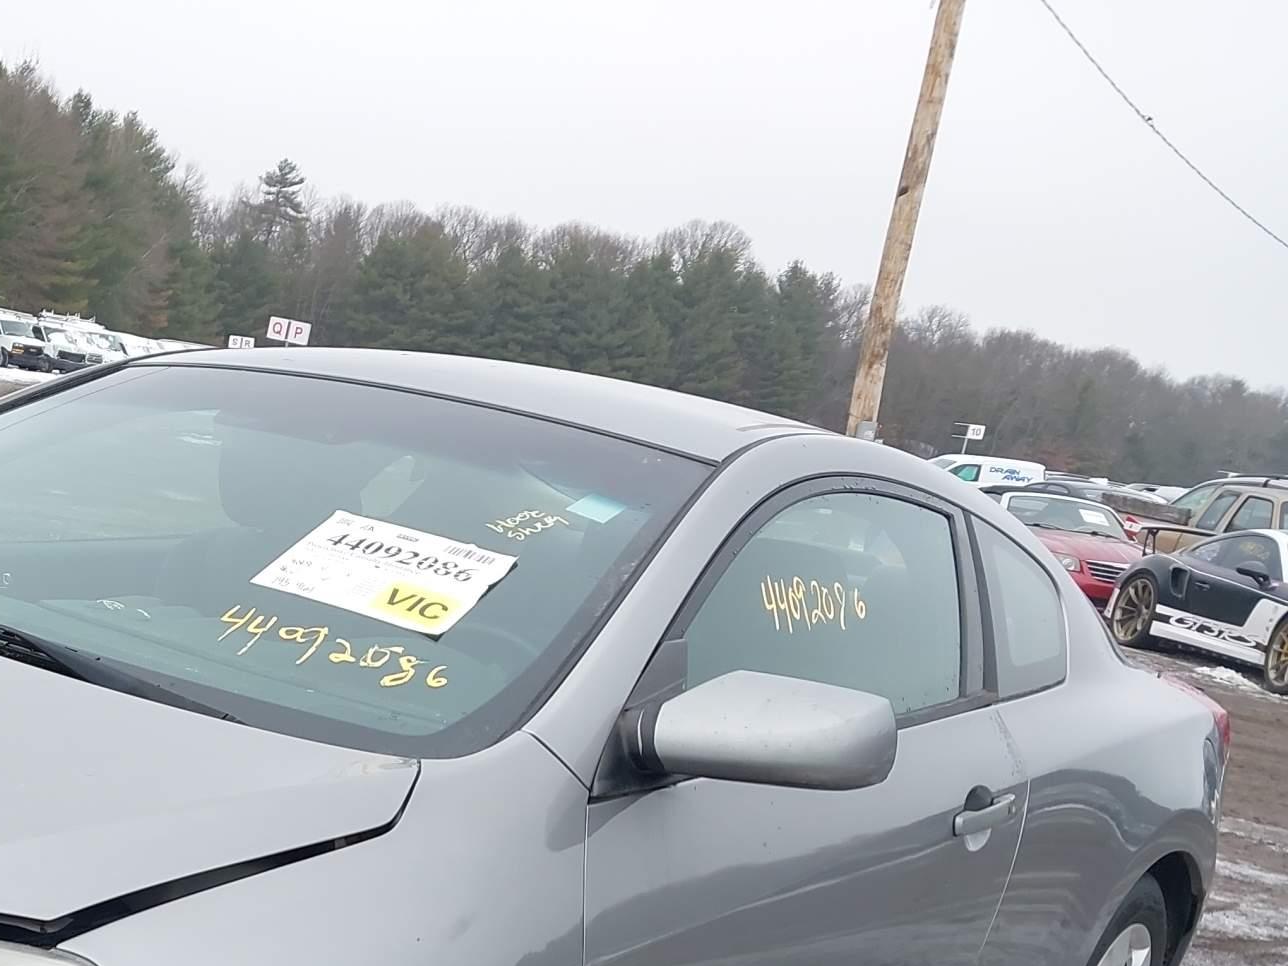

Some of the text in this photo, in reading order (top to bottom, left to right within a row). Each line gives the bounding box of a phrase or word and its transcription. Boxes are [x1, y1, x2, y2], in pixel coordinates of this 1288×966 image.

[273, 322, 304, 339] Q P
[327, 533, 479, 583] 44092086
[386, 587, 449, 620] VIC
[218, 605, 449, 688] 44092086
